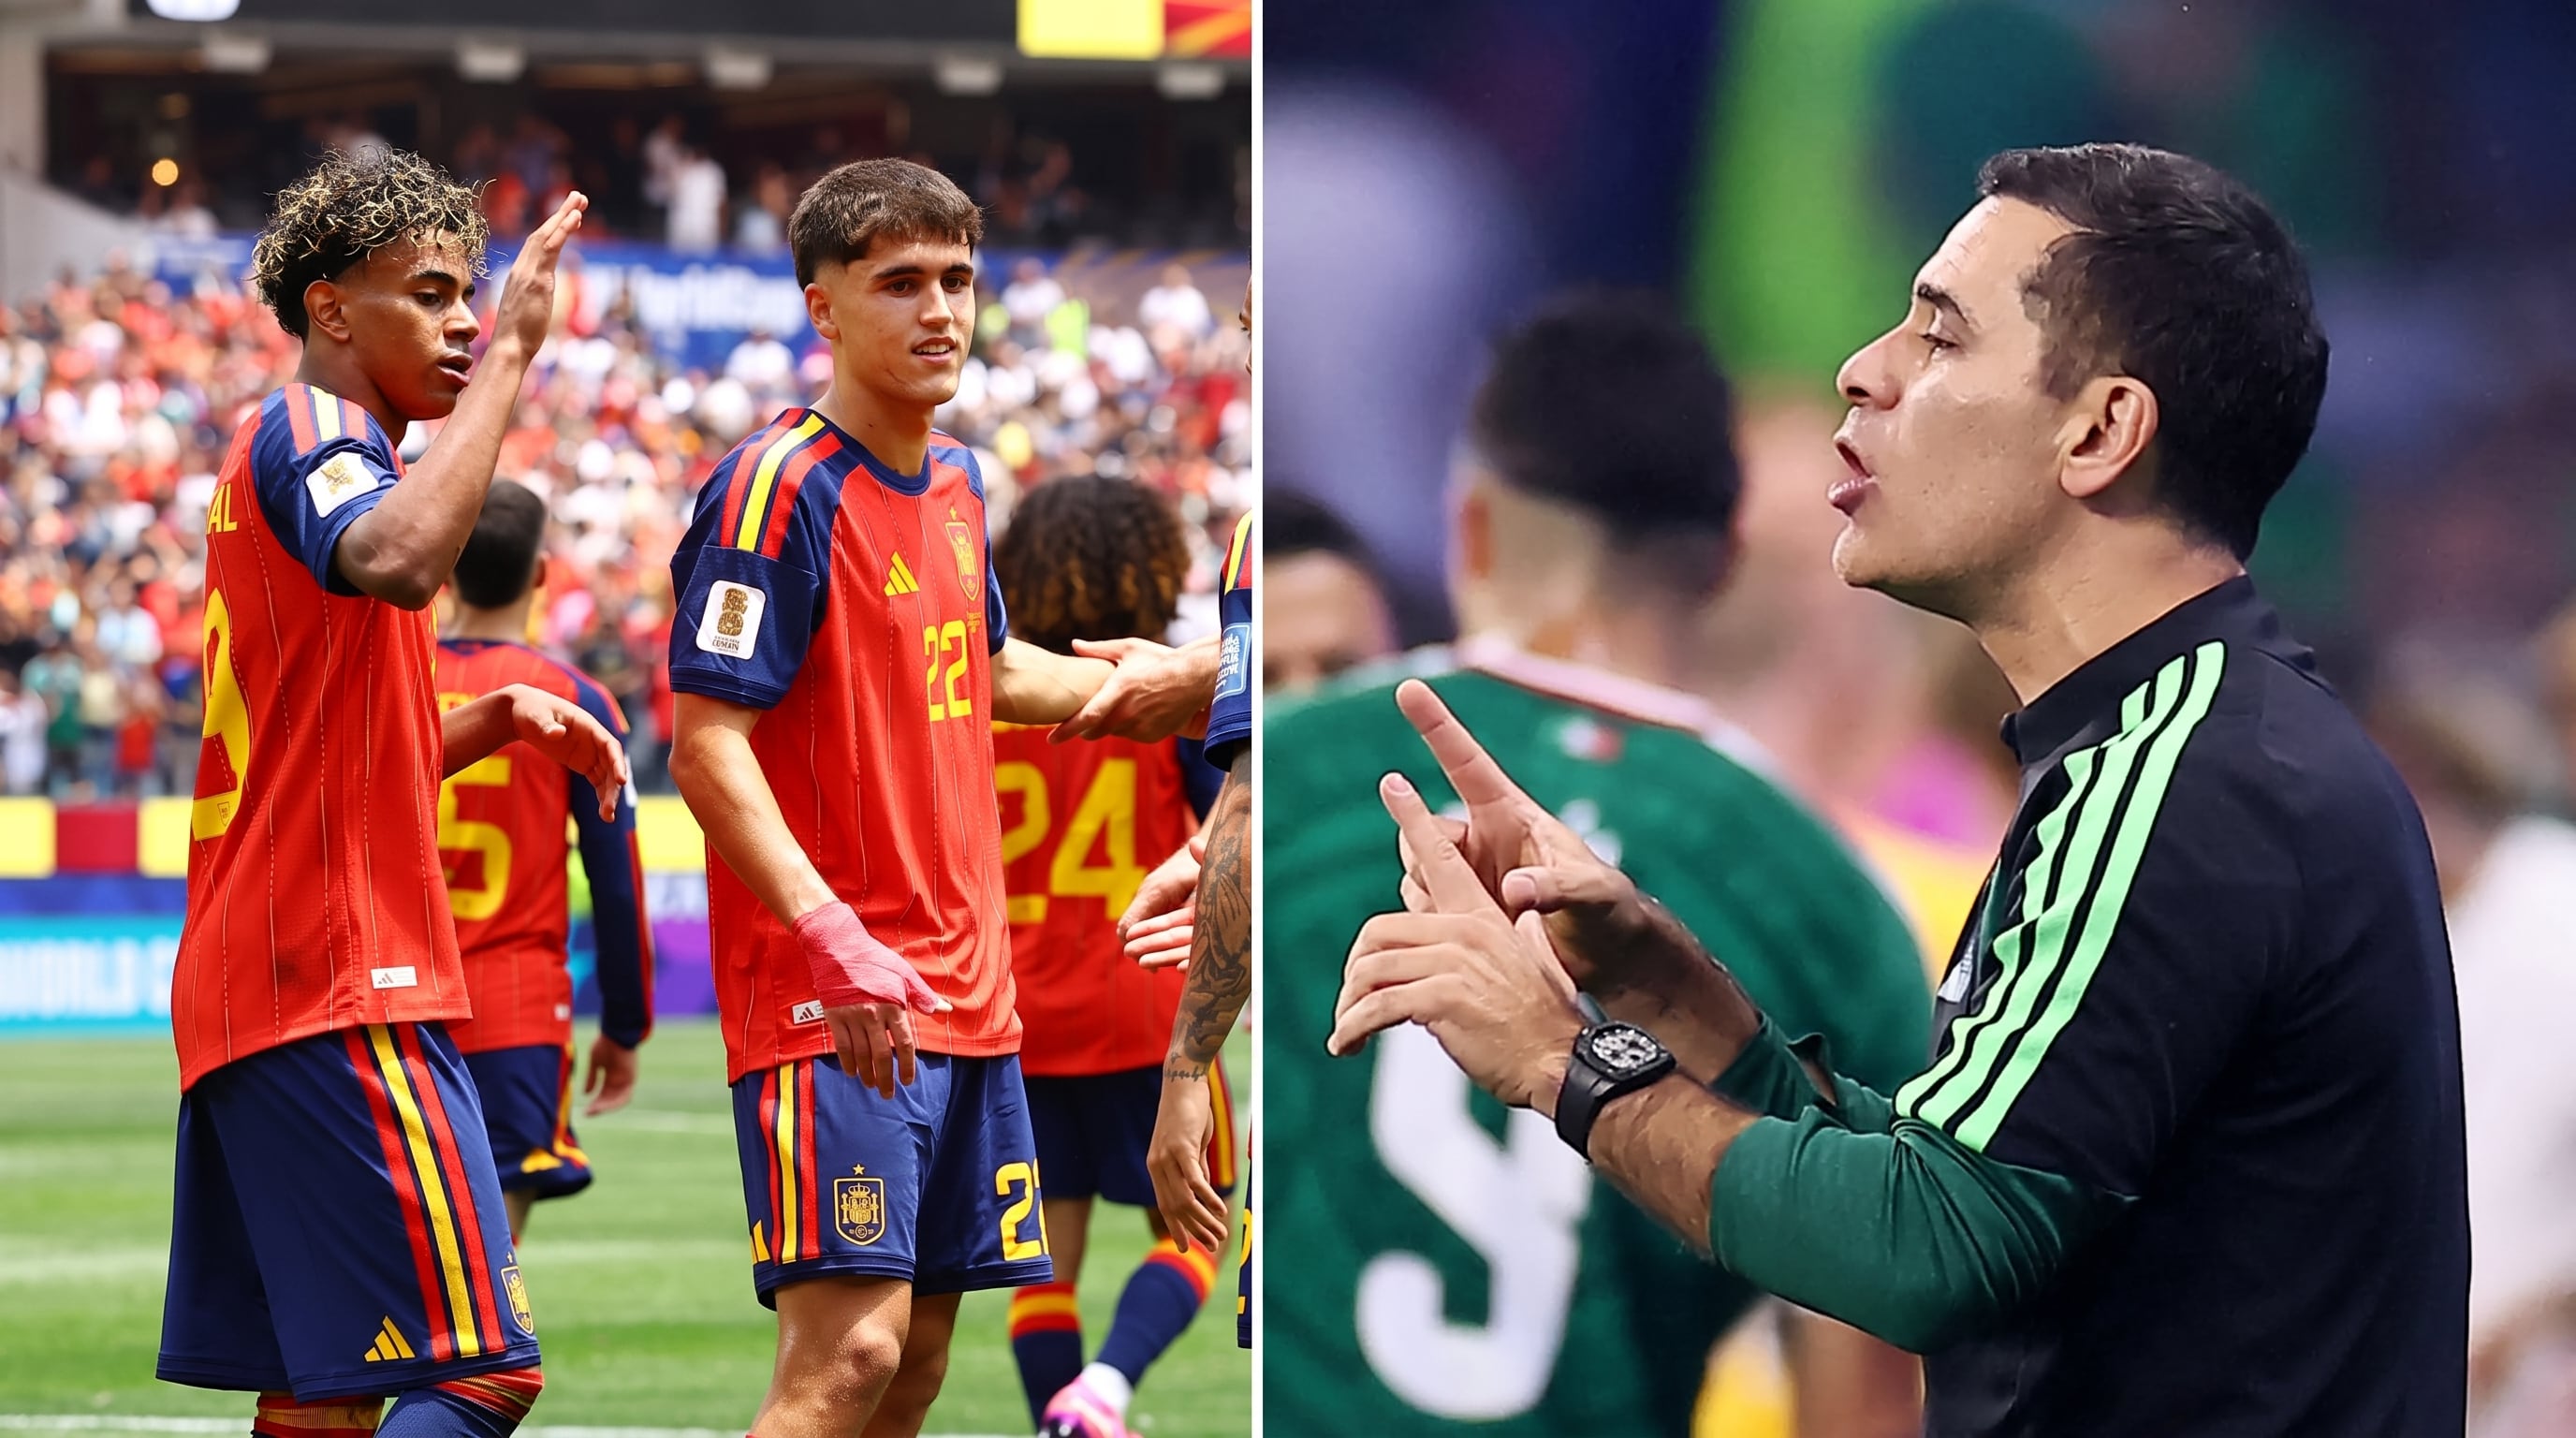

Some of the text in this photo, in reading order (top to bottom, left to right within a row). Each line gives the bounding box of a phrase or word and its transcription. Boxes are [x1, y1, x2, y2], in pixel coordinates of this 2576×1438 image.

[206, 482, 238, 535] AL
[924, 619, 973, 722] 22
[437, 754, 512, 921] 5
[995, 759, 1148, 924] 24
[1355, 1014, 1594, 1421] 9
